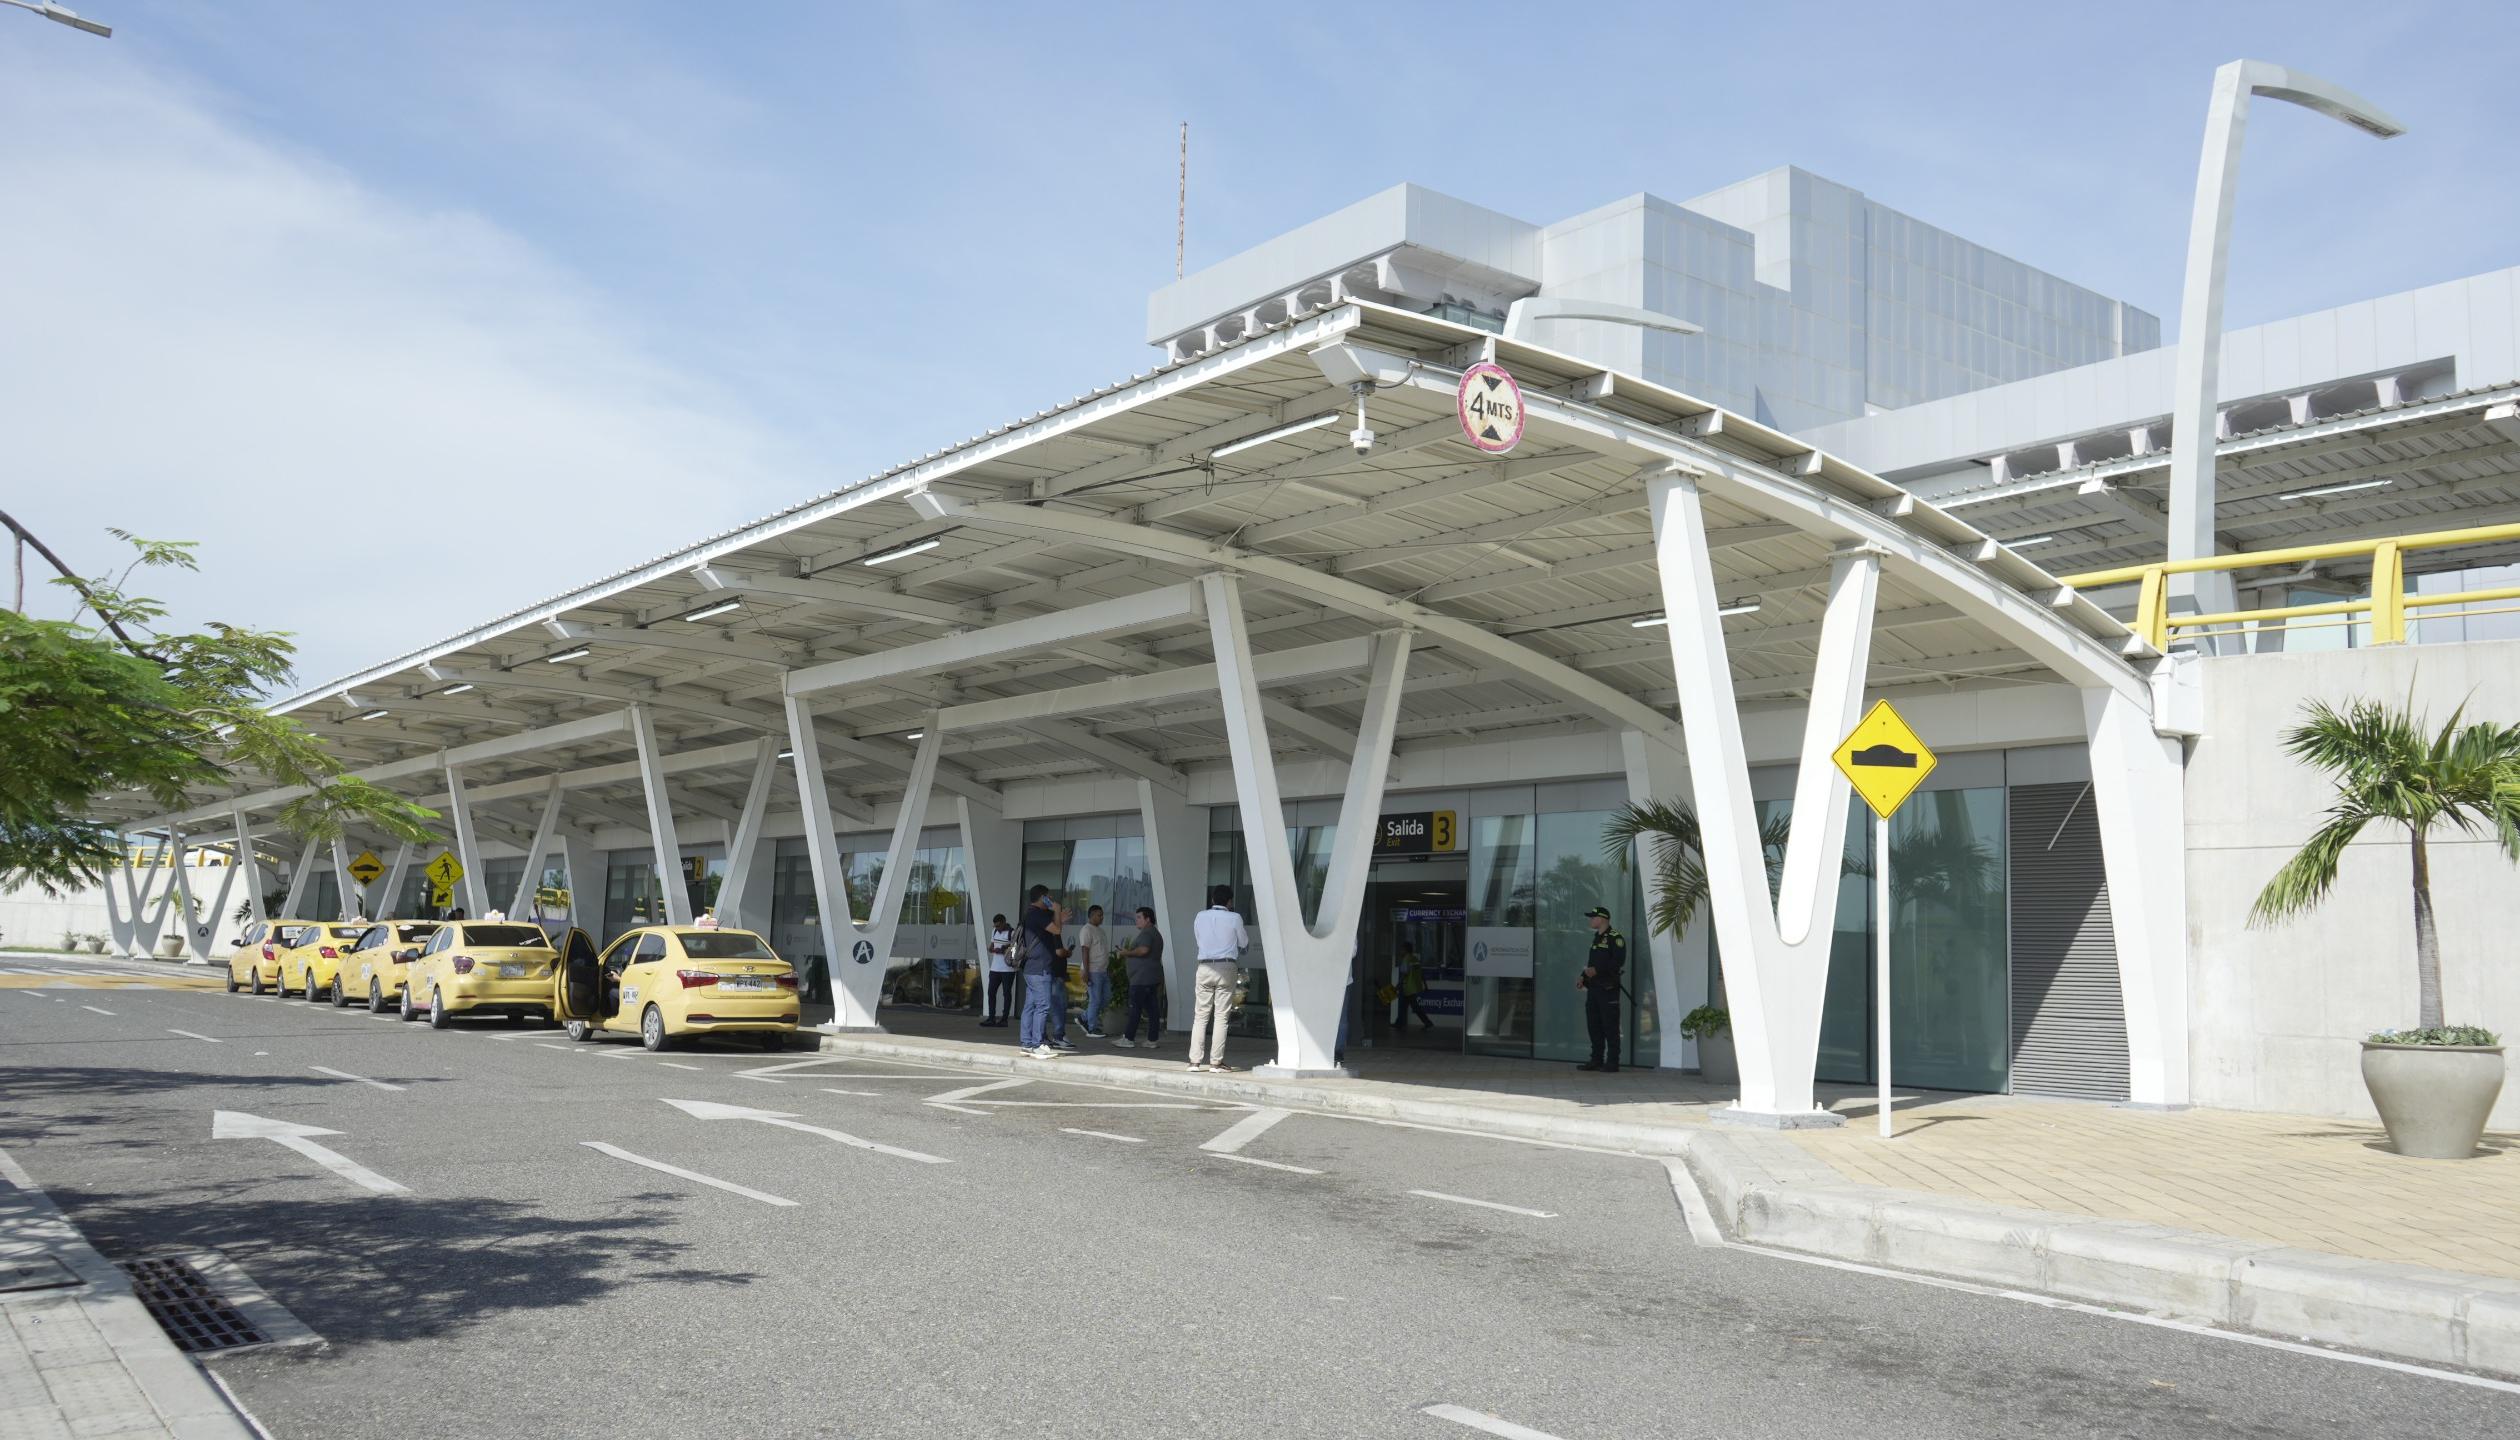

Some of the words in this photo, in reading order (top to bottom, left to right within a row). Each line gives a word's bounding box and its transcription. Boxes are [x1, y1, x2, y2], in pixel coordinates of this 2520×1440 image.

[1470, 391, 1484, 420] 4
[1487, 400, 1512, 420] MTS
[1387, 819, 1424, 836] Salida
[1437, 816, 1449, 845] 3
[1386, 837, 1401, 847] Exit
[695, 859, 702, 876] 2
[1409, 909, 1441, 917] CURRENCY
